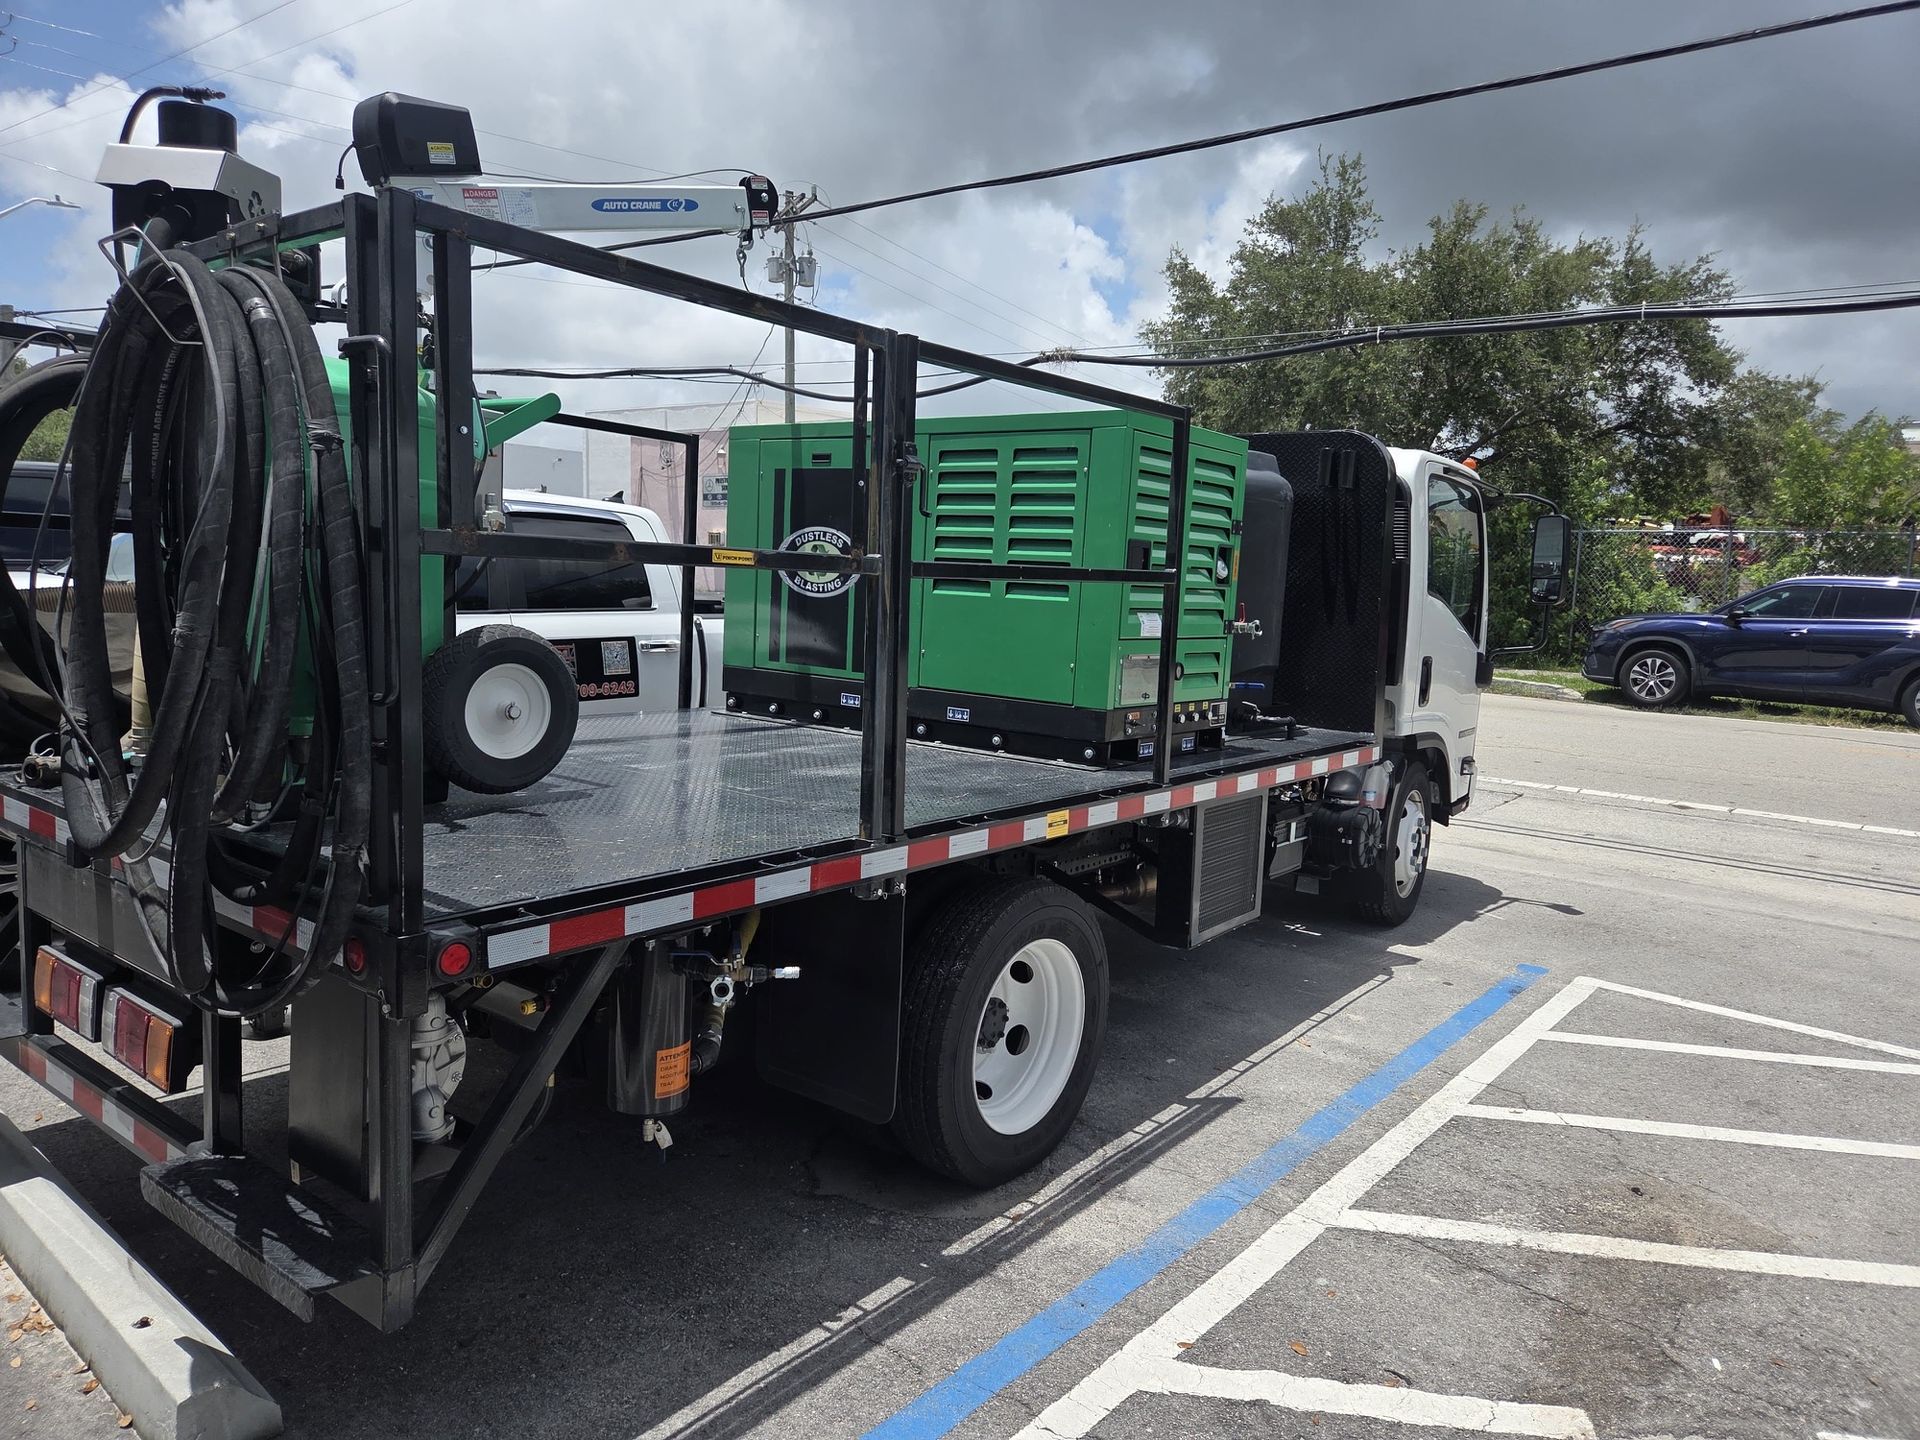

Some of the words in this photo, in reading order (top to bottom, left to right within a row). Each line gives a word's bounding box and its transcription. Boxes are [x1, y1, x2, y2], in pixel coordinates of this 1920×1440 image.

[469, 190, 497, 198] DANGER
[602, 201, 629, 210] AUTO
[630, 201, 661, 210] CRANE
[153, 383, 168, 431] ABRASIVE
[162, 342, 180, 381] MATERIA
[795, 531, 844, 548] DUSTLESS
[794, 575, 842, 592] BLASTING
